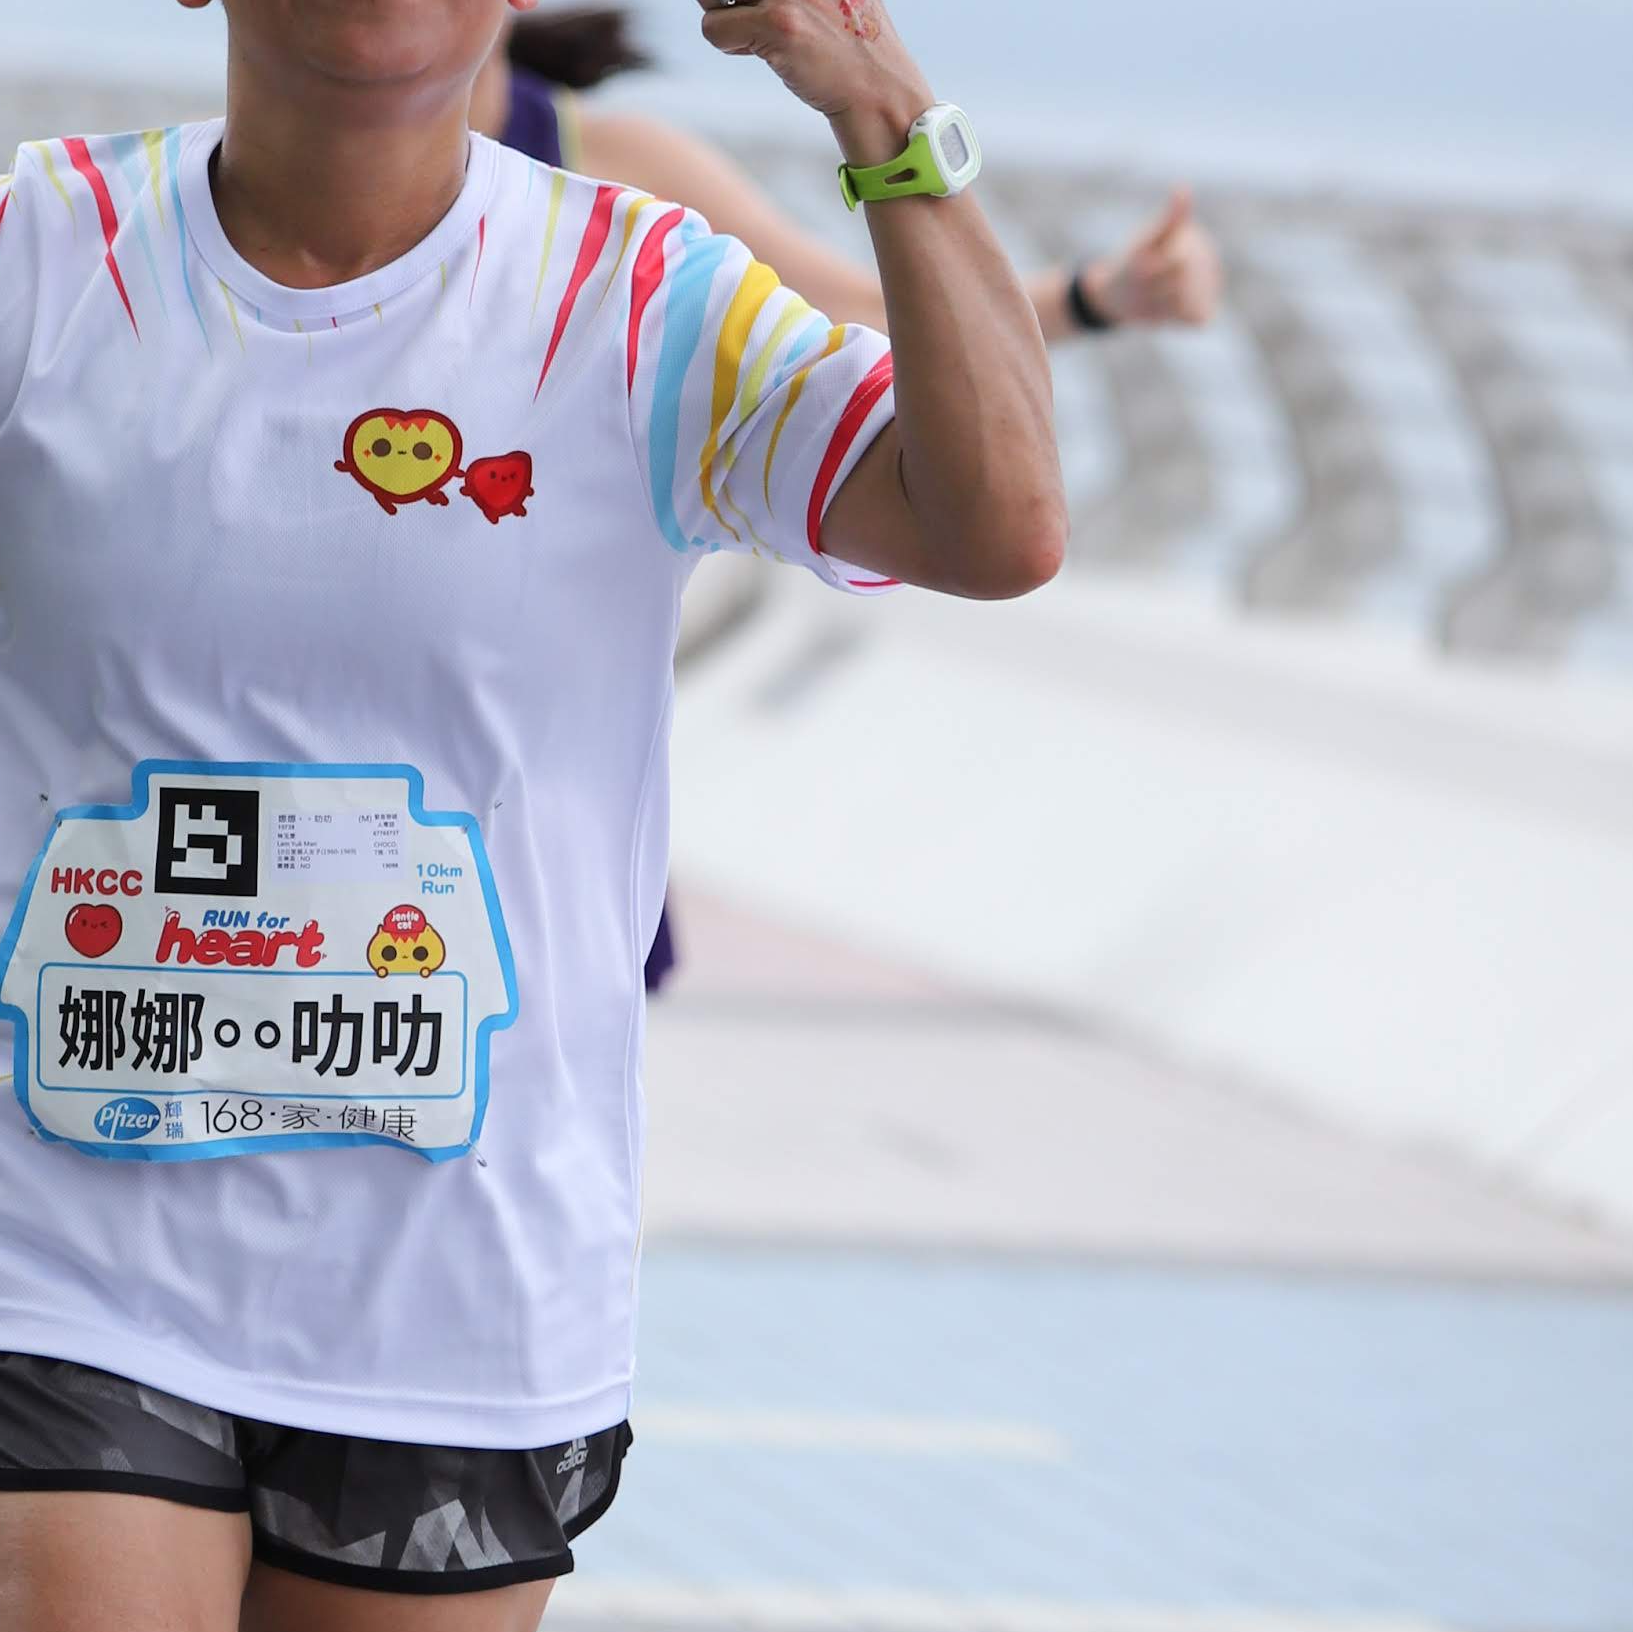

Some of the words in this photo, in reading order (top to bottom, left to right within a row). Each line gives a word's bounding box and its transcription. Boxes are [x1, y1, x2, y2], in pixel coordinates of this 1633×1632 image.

[51, 867, 143, 896] HKCC
[416, 863, 463, 877] 10km
[421, 880, 455, 894] Run
[202, 909, 250, 928] RUN
[257, 912, 290, 929] for
[155, 910, 324, 967] heart
[99, 1104, 161, 1139] Pfizer
